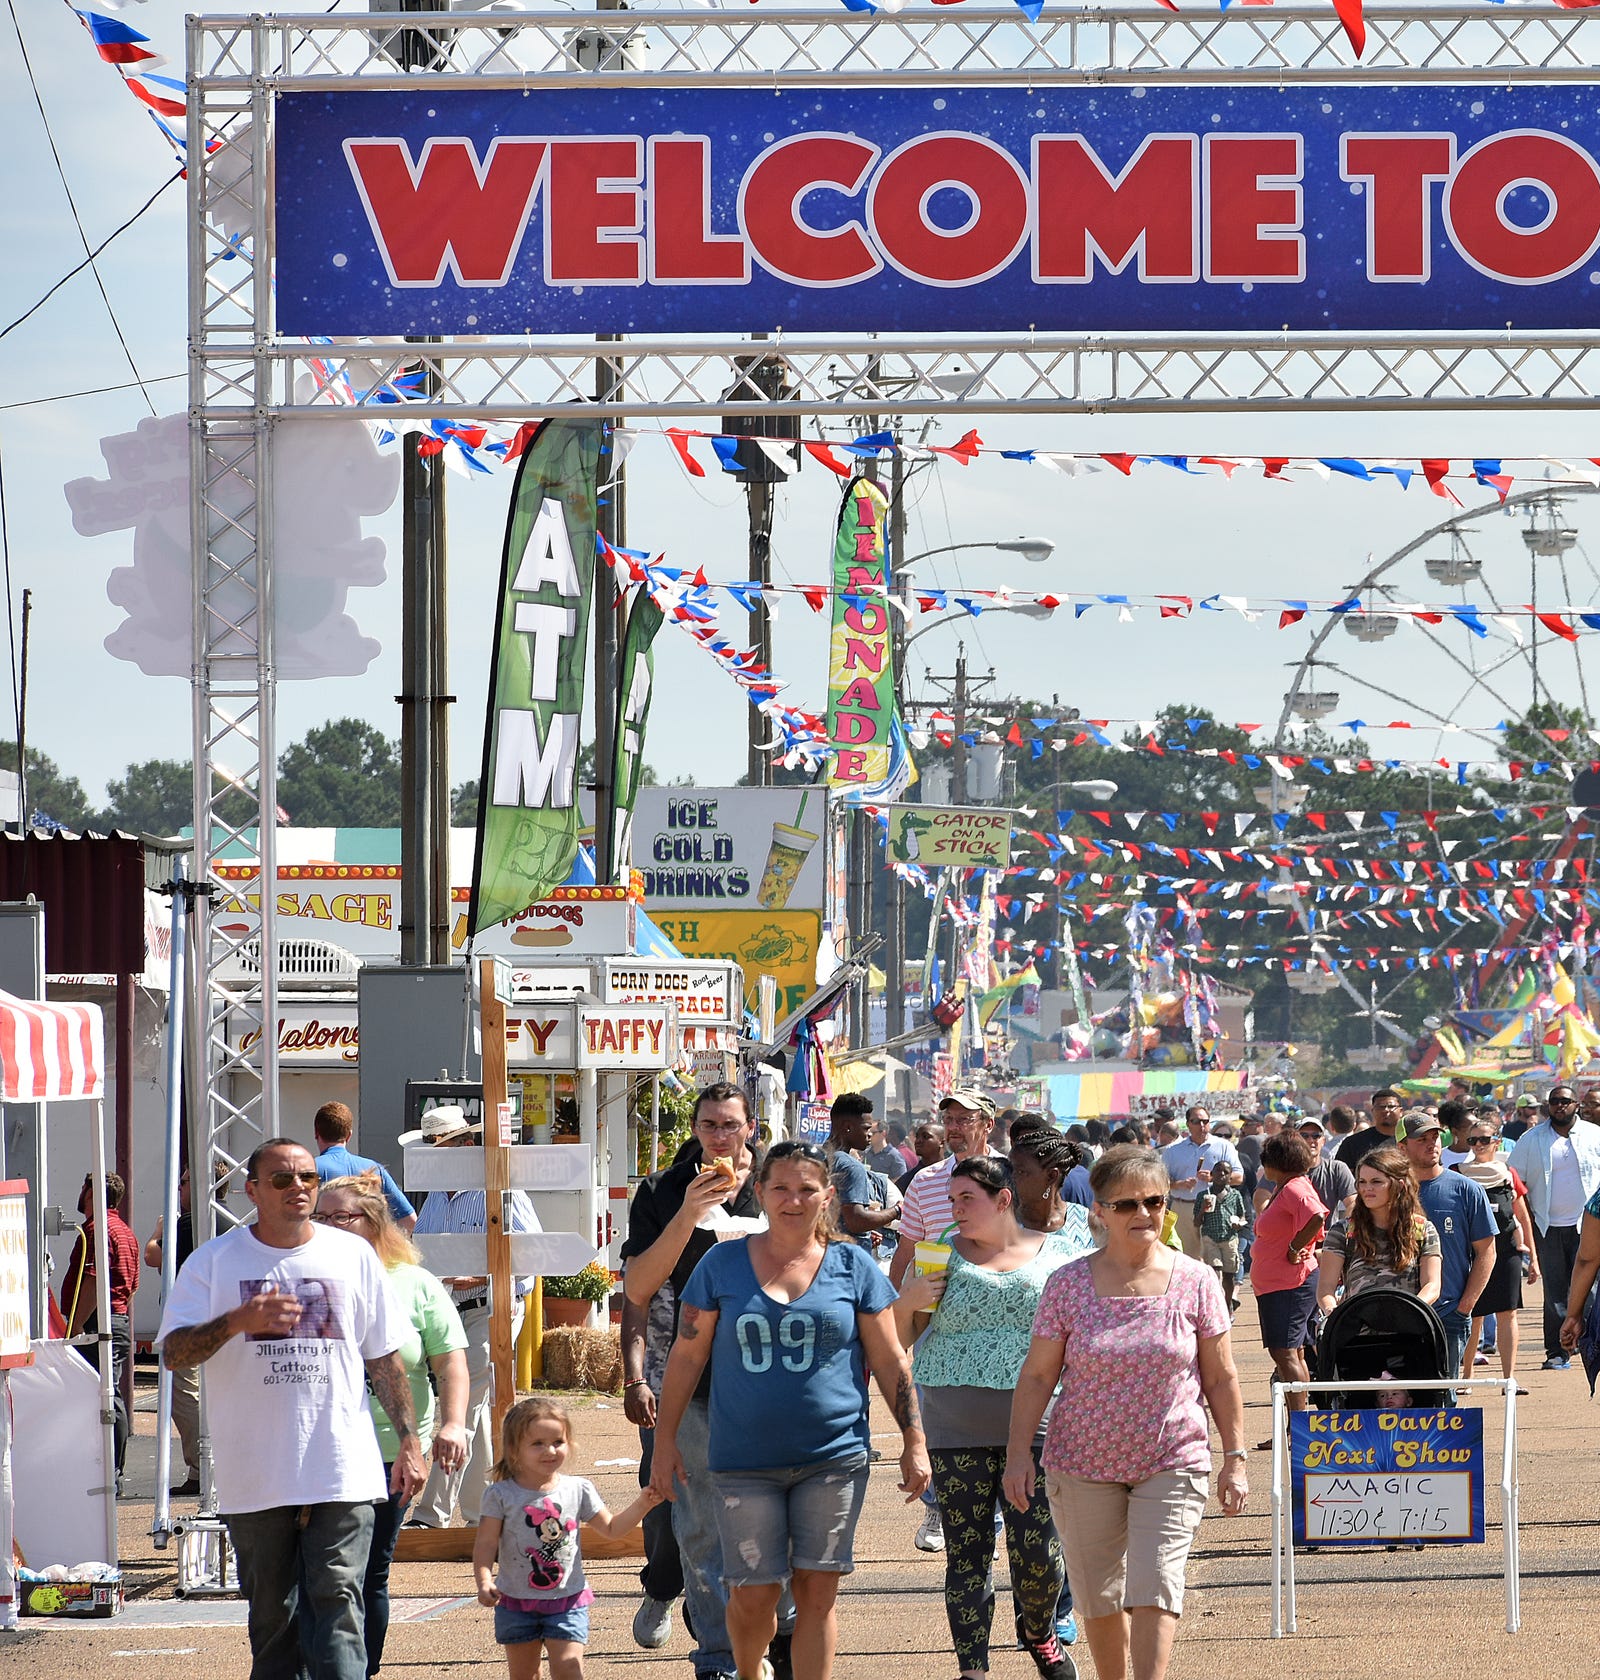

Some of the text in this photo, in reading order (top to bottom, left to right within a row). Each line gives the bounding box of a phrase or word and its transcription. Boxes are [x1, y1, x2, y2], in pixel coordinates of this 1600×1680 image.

[342, 130, 1306, 289] WELCOME
[493, 497, 581, 809] ATM
[667, 797, 718, 829] ICE
[932, 813, 1007, 830] GATOR
[951, 829, 987, 840] ON A
[653, 833, 734, 865] COLD
[933, 838, 1001, 855] STICK
[642, 866, 750, 898] DRINKS
[612, 972, 688, 991] CORN DOGS
[692, 974, 709, 989] Root
[707, 974, 724, 989] Beer
[585, 1018, 664, 1055] TAFFY
[1139, 1095, 1188, 1110] STEAK
[256, 1343, 333, 1357] Ministry of
[736, 1310, 816, 1373] 09
[271, 1361, 321, 1373] Tattoos
[263, 1374, 330, 1385] 601-728-1726
[1308, 1411, 1464, 1433] Kid Davie
[1303, 1437, 1472, 1468] Next Show
[1326, 1478, 1434, 1497] MAGIC
[1320, 1508, 1370, 1537] 11:30
[1399, 1507, 1450, 1532] 7:15
